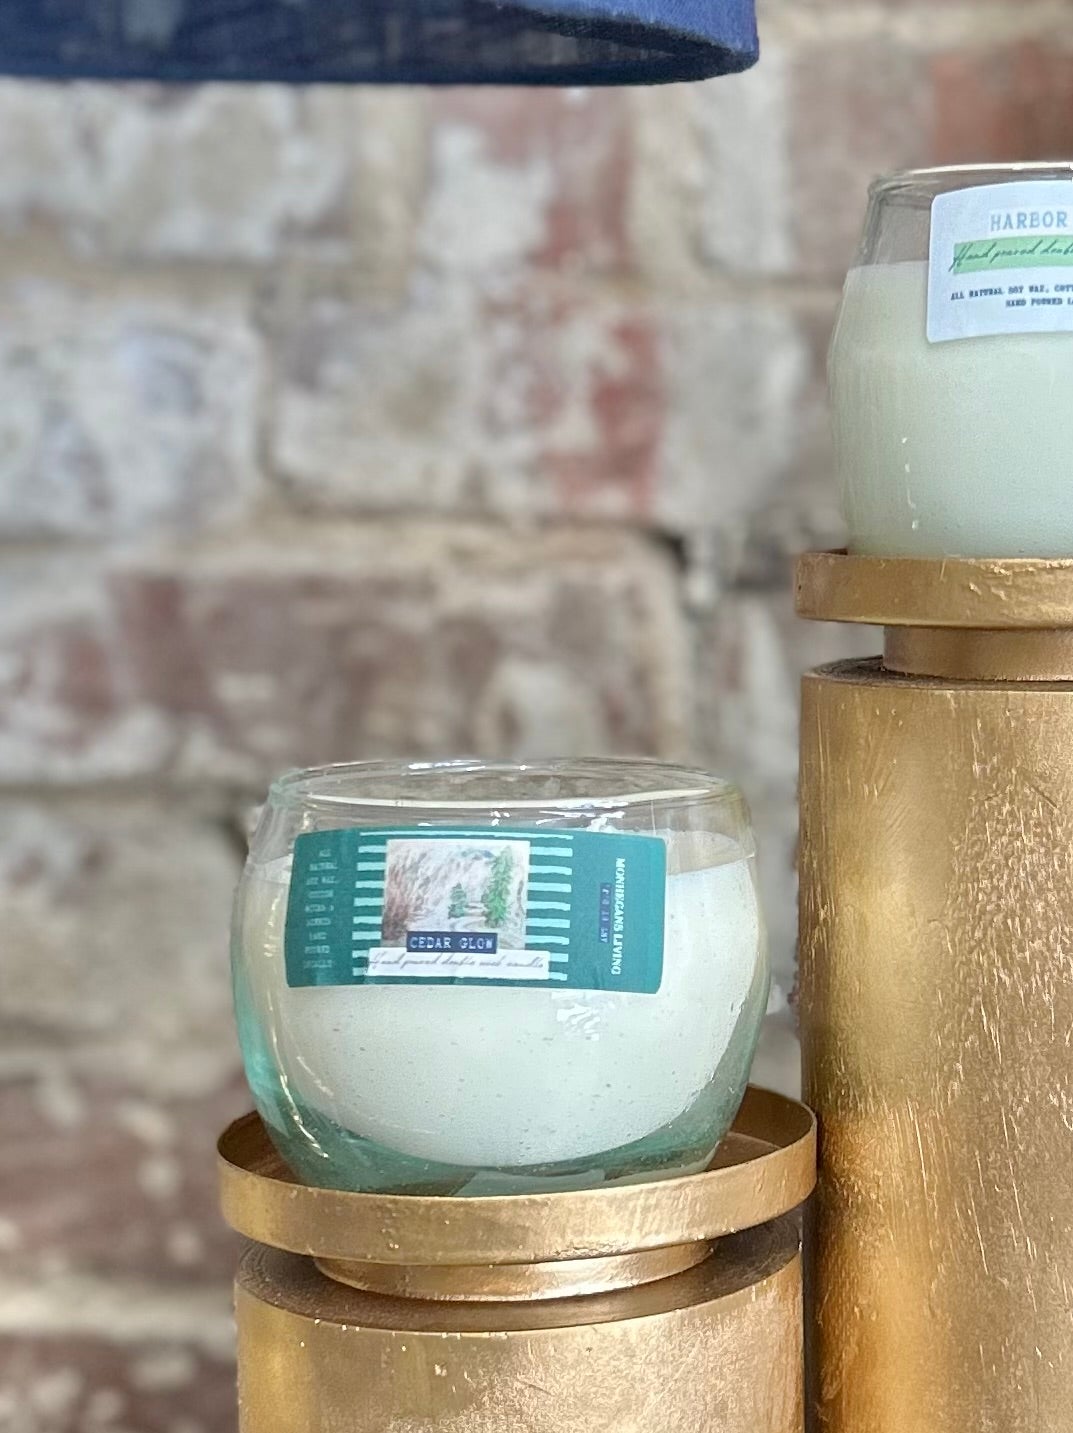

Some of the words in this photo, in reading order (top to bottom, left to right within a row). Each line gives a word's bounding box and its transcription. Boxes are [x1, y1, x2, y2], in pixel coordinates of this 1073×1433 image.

[989, 211, 1068, 233] HARBOR
[948, 241, 996, 272] Hand
[950, 291, 965, 301] ALL
[409, 936, 452, 950] CEDAR
[460, 936, 494, 950] GLOW
[610, 933, 625, 976] LIVING
